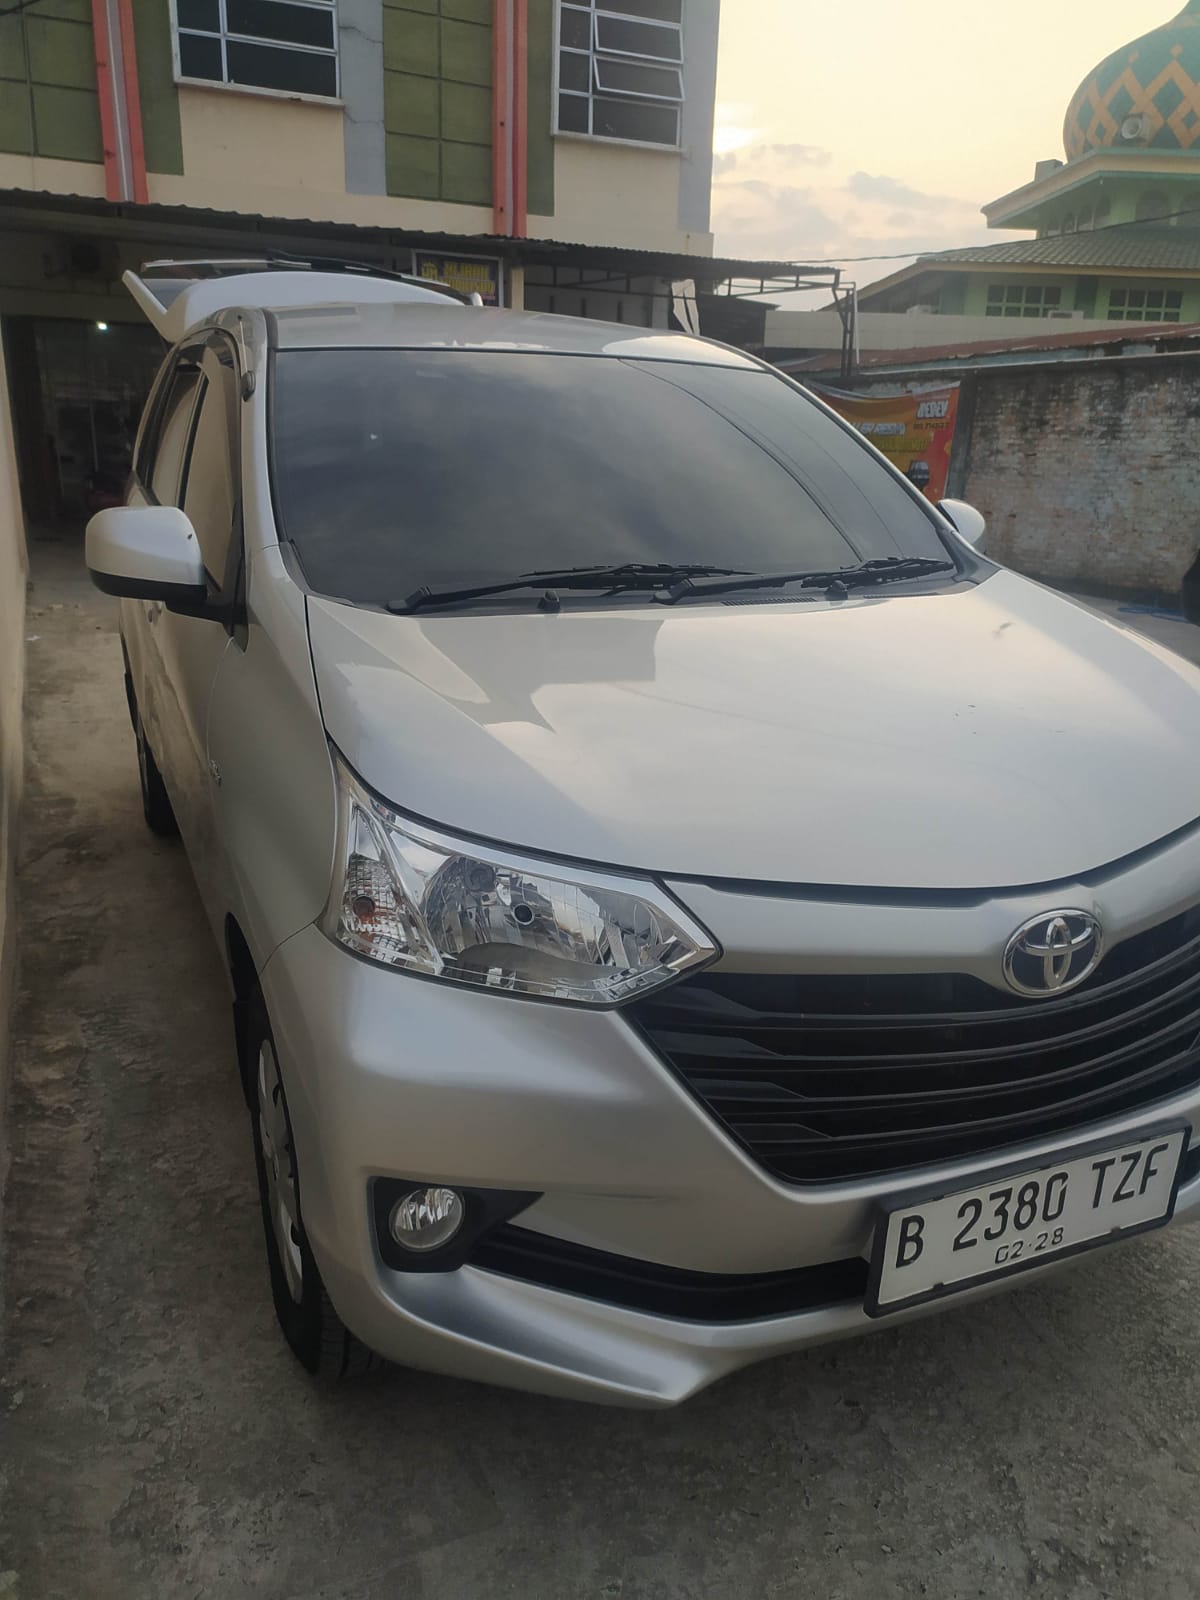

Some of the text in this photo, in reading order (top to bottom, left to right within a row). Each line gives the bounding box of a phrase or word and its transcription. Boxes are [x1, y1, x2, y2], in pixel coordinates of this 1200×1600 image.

[896, 1143, 1169, 1268] B 2380 TZF
